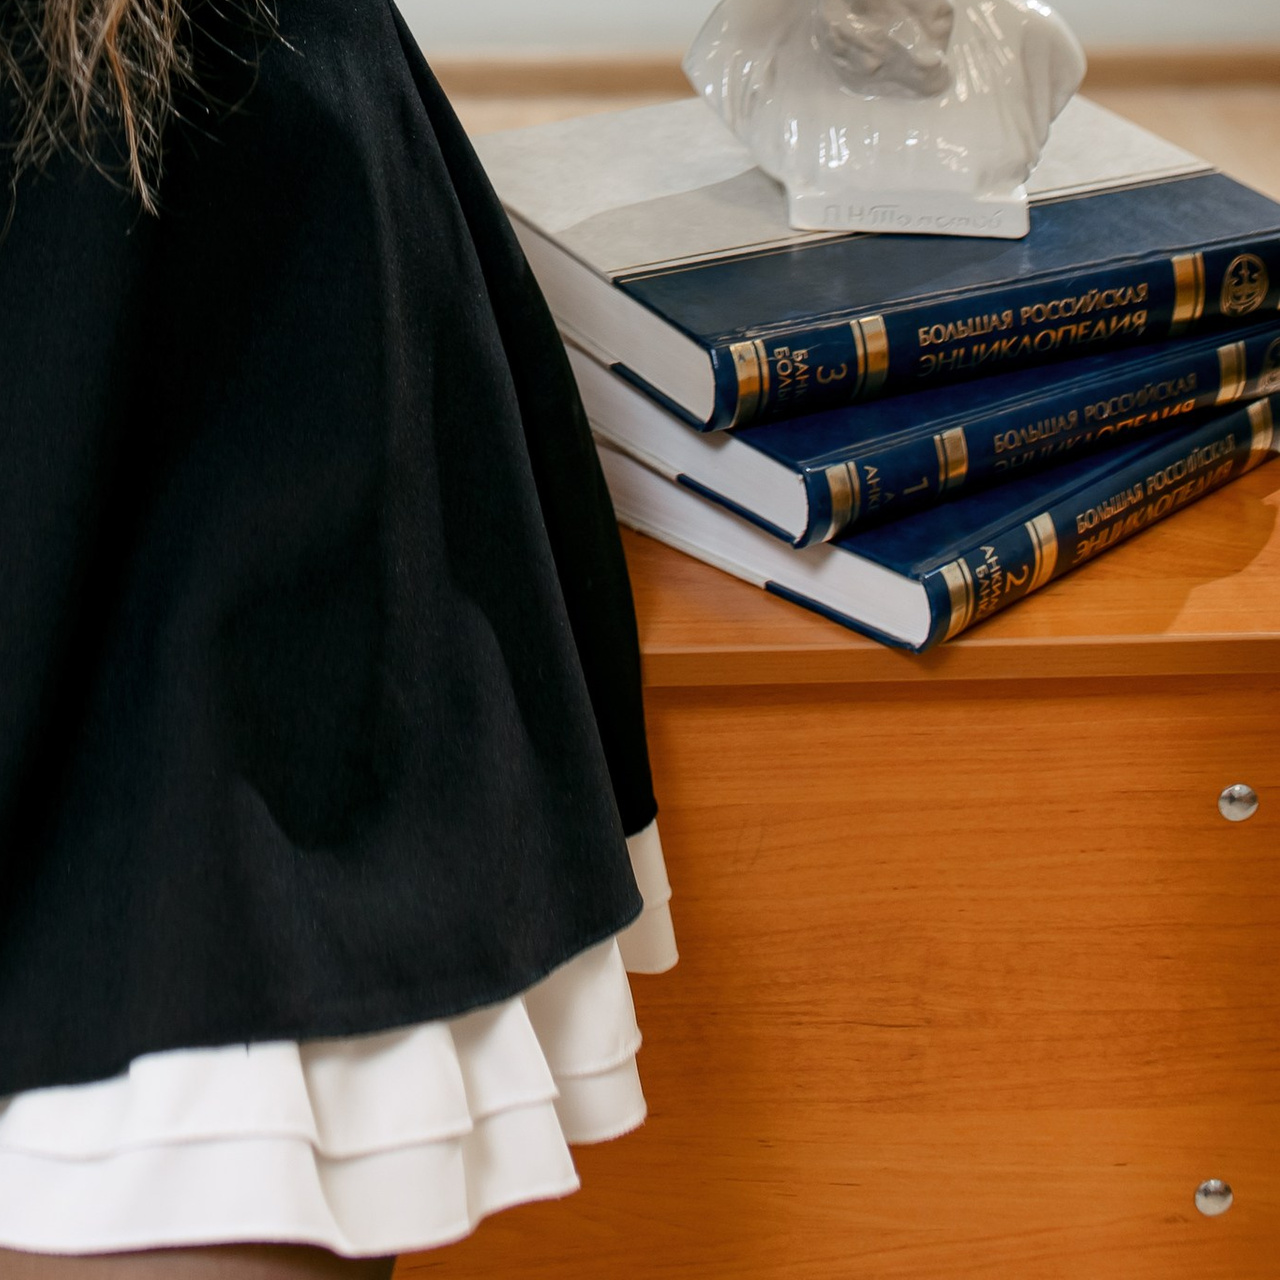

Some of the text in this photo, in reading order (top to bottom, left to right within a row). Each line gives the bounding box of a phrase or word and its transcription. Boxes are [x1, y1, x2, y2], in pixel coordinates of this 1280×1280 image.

[917, 309, 1149, 378] ЭНЦИКЛОПЕДИЯ
[918, 282, 1149, 348] БОЛЬШАЯ РОССИЙСКАЯ
[816, 362, 849, 385] 3
[993, 372, 1198, 455] БОЛЬШАЯ РОССИЙСКАЯ
[1075, 433, 1236, 535] БОЛЬШАЯ РОССИЙСКАЯ
[1004, 563, 1031, 594] 2
